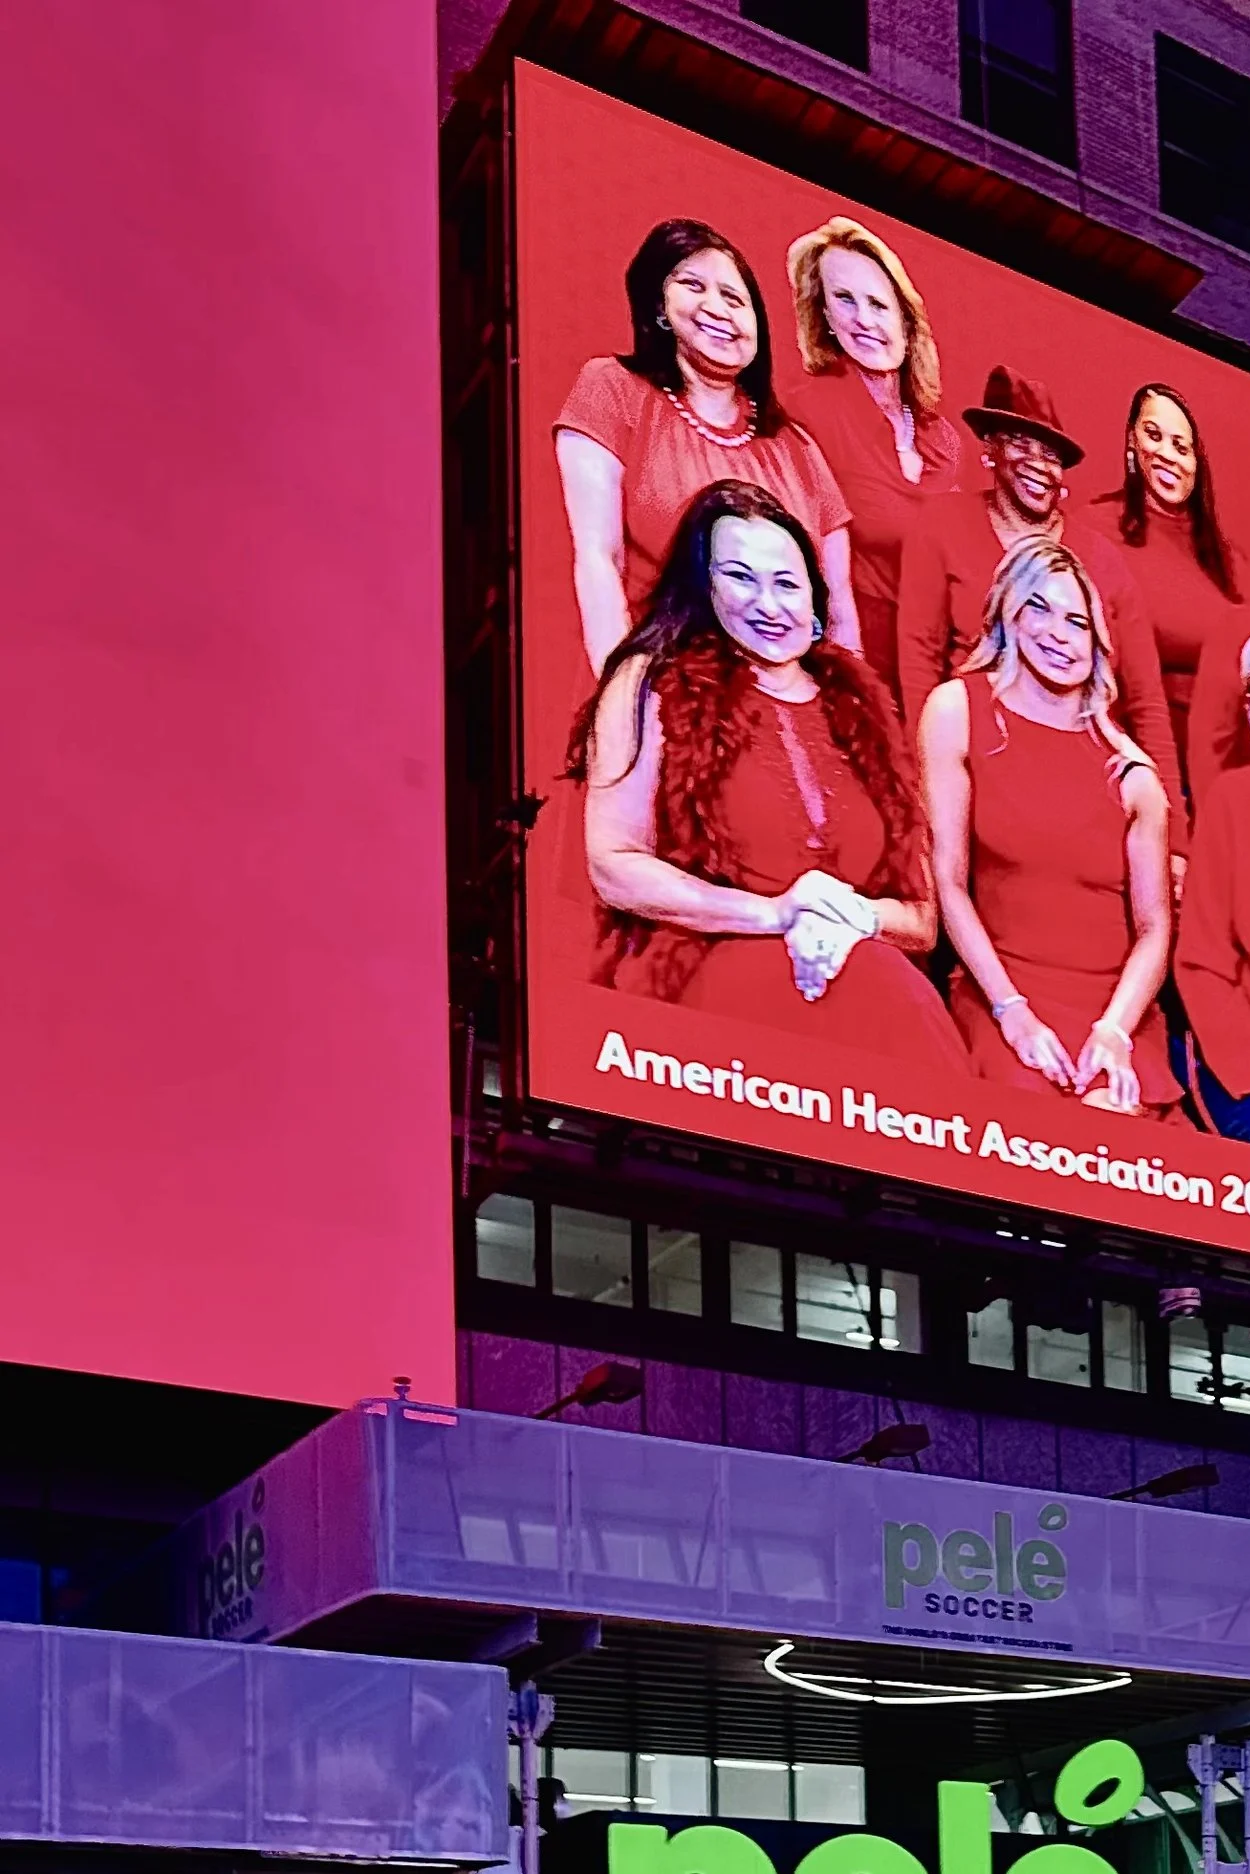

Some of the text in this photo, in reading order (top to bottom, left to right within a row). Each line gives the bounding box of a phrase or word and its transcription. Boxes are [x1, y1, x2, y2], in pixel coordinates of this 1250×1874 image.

[595, 1030, 832, 1123] American
[841, 1086, 972, 1154] Heart
[977, 1120, 1214, 1208] Association
[883, 1503, 1068, 1609] pelé
[924, 1593, 1034, 1624] SOCCER
